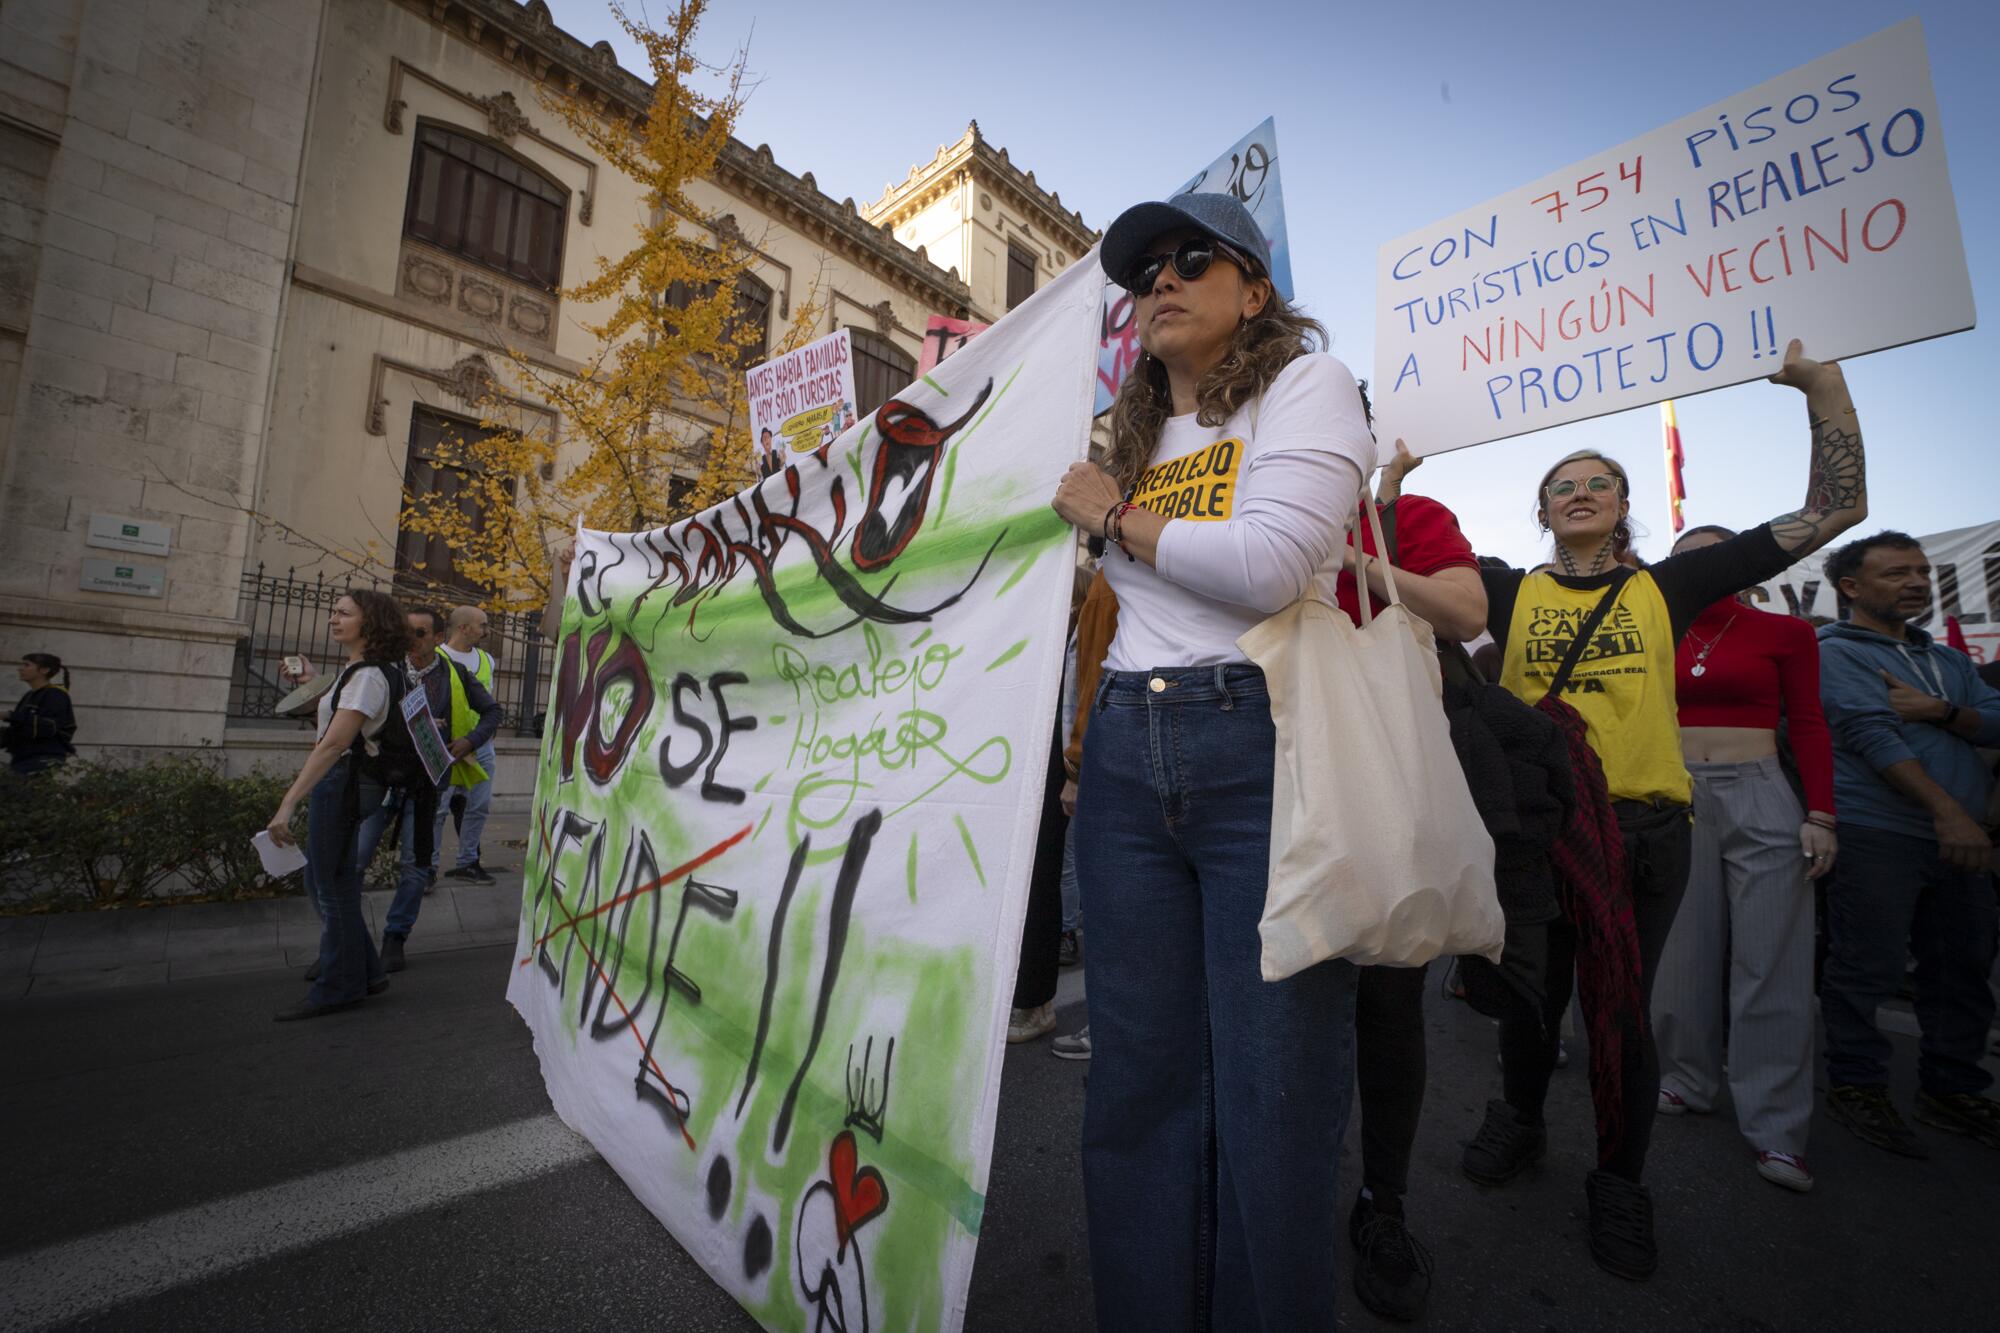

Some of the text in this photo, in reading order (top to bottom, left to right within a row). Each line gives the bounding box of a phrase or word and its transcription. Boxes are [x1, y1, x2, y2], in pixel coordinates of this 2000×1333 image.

[1630, 198, 1688, 252] EN
[1708, 107, 1926, 228] REALEJO
[1392, 215, 1498, 281] CON
[1530, 155, 1644, 224] 754
[750, 336, 847, 400] ANTES HABÍA FAMILIAS
[756, 396, 773, 425] HOY
[776, 388, 797, 419] SÓLO
[798, 369, 842, 410] TURISTAS
[1393, 353, 1421, 392] A
[1486, 322, 1724, 419] PROTEJO
[1136, 441, 1234, 496] REALEJO
[548, 621, 758, 805] NO SE
[1562, 679, 1605, 693] YA
